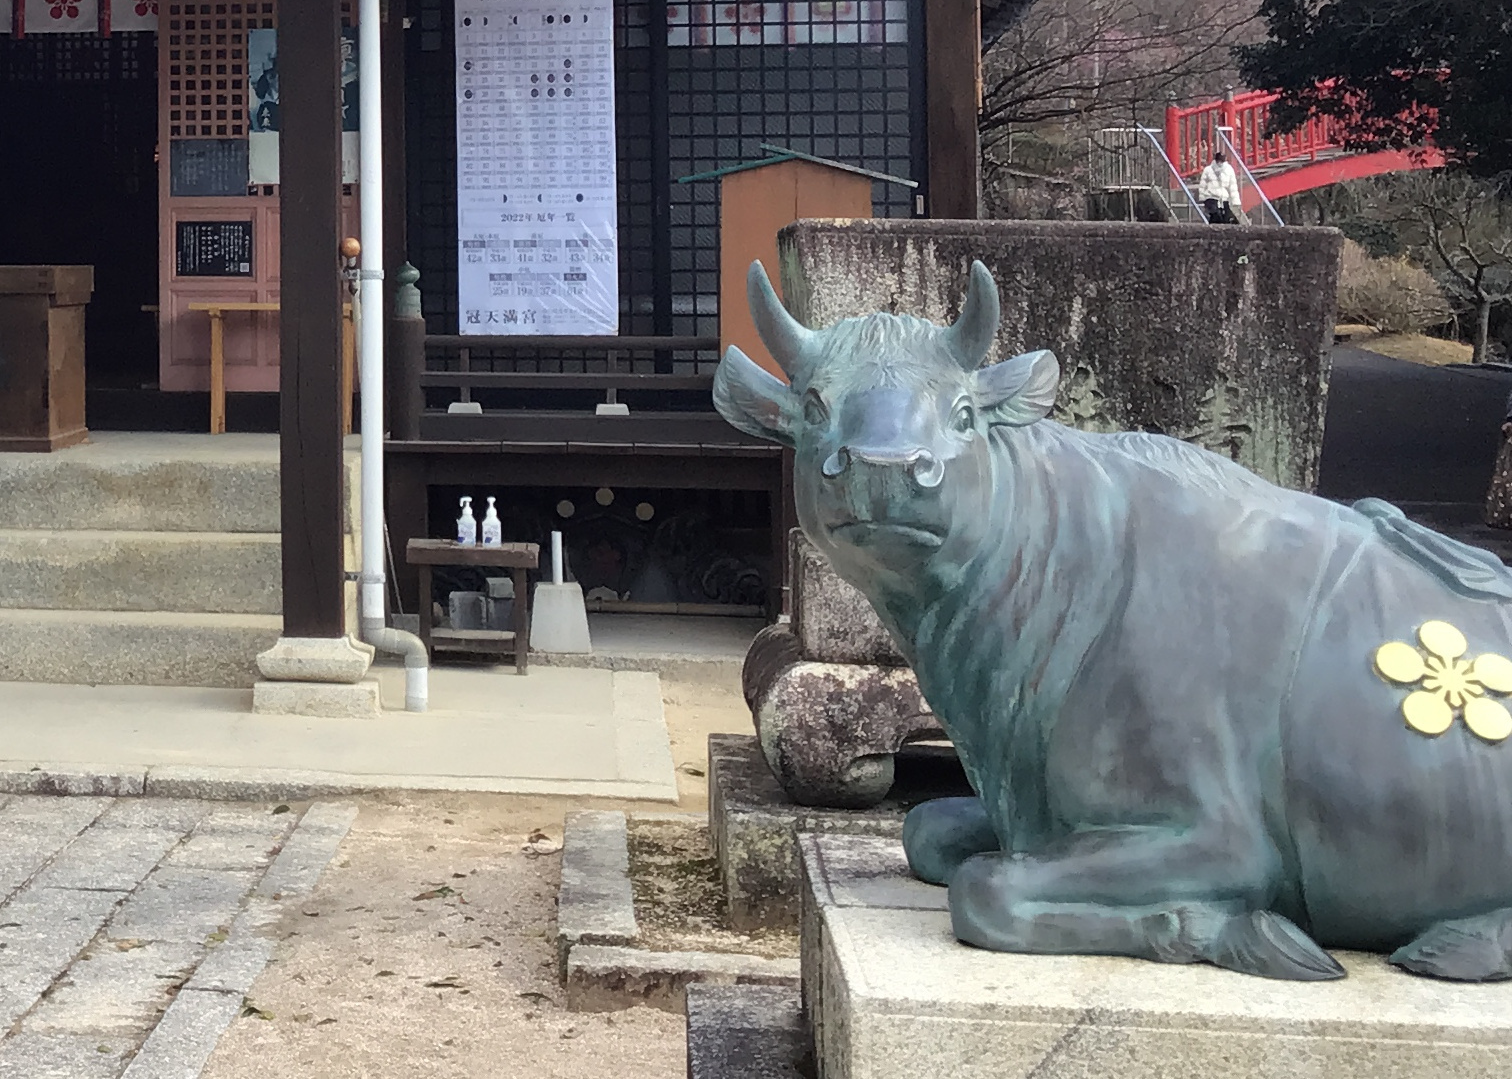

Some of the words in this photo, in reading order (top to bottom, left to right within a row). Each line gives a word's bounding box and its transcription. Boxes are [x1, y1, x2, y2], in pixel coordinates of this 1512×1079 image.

[500, 212, 533, 222] 2022年
[465, 309, 537, 324] 冠天満宮
